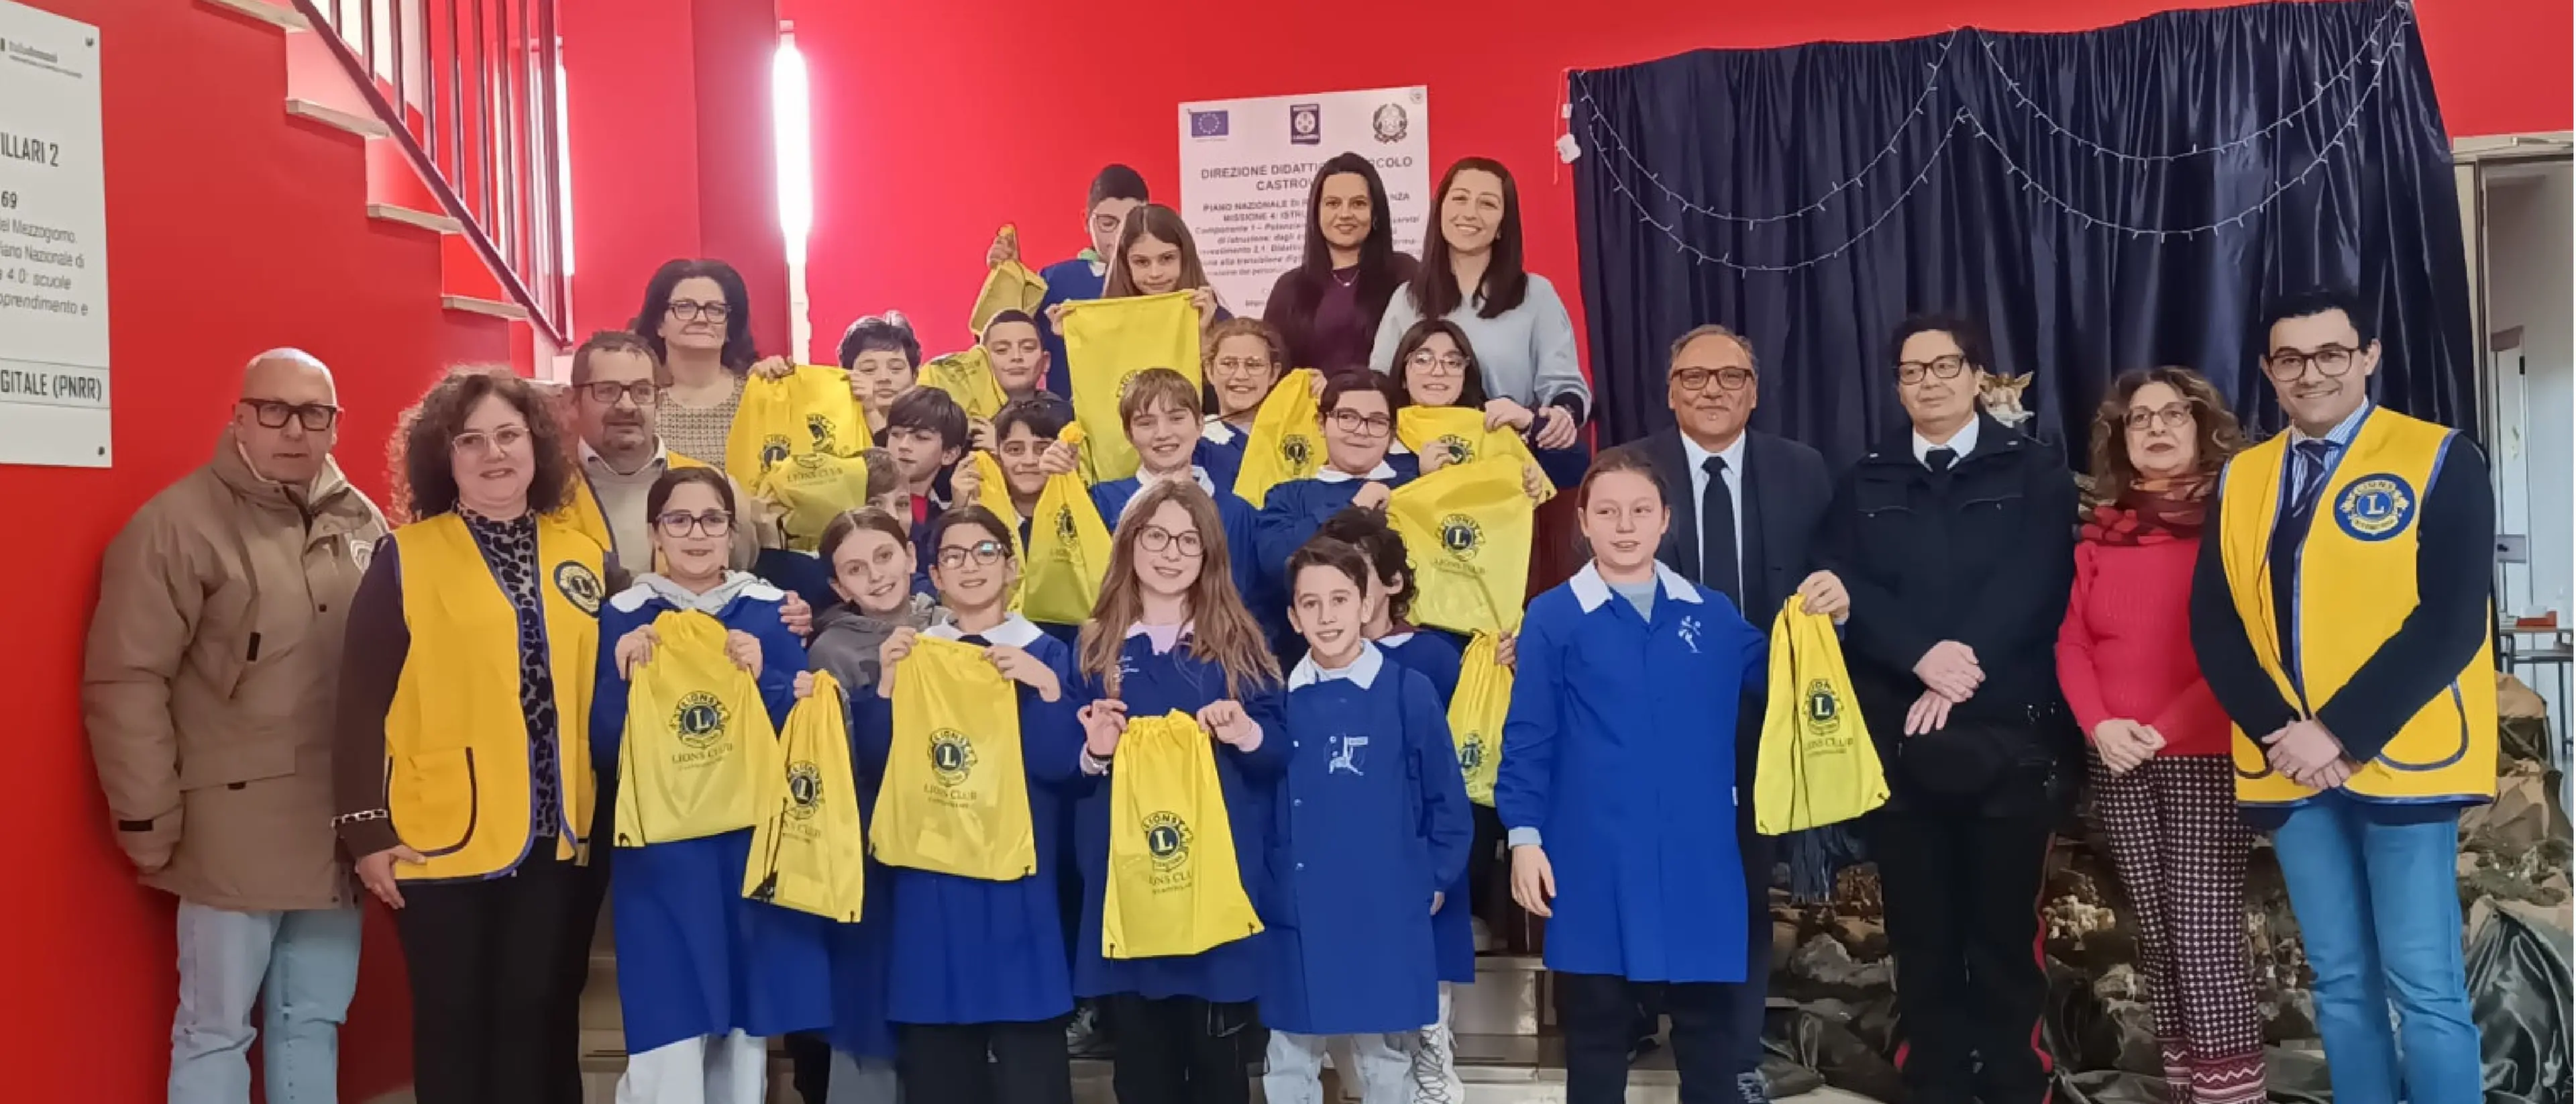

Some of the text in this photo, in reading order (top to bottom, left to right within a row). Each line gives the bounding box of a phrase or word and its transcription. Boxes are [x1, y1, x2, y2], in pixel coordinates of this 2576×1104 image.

[50, 142, 58, 167] 2
[1201, 165, 1267, 180] DIREZIONE
[1256, 179, 1311, 191] CASTRO
[80, 303, 89, 317] e
[52, 374, 102, 403] (PNRR)
[2367, 495, 2385, 515] L
[1453, 529, 1467, 546] L
[1815, 697, 1830, 717] L
[694, 709, 710, 730] L
[942, 746, 957, 767] L
[1155, 830, 1173, 851] L
